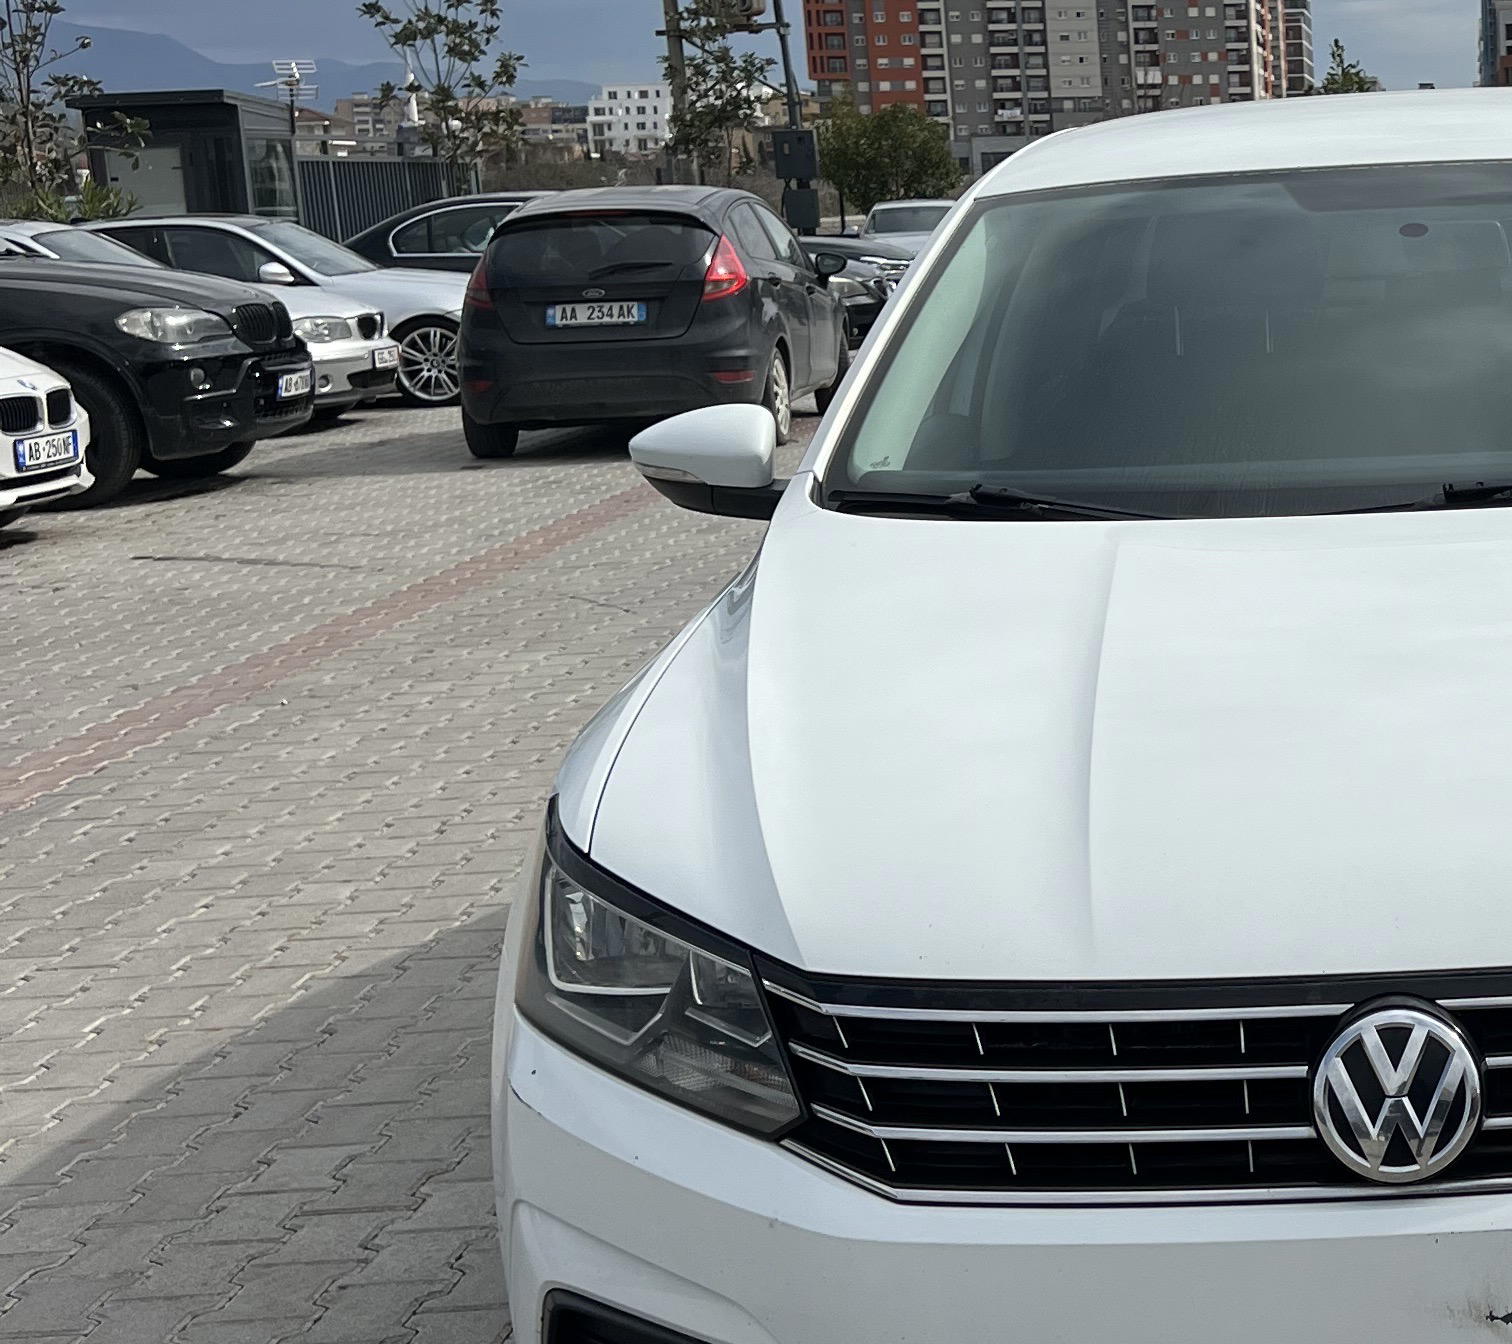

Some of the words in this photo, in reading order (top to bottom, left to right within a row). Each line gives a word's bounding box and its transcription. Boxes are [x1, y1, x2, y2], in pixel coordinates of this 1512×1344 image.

[560, 306, 578, 322] AA
[586, 304, 613, 321] 234
[617, 303, 636, 319] AK
[28, 441, 41, 462] AB
